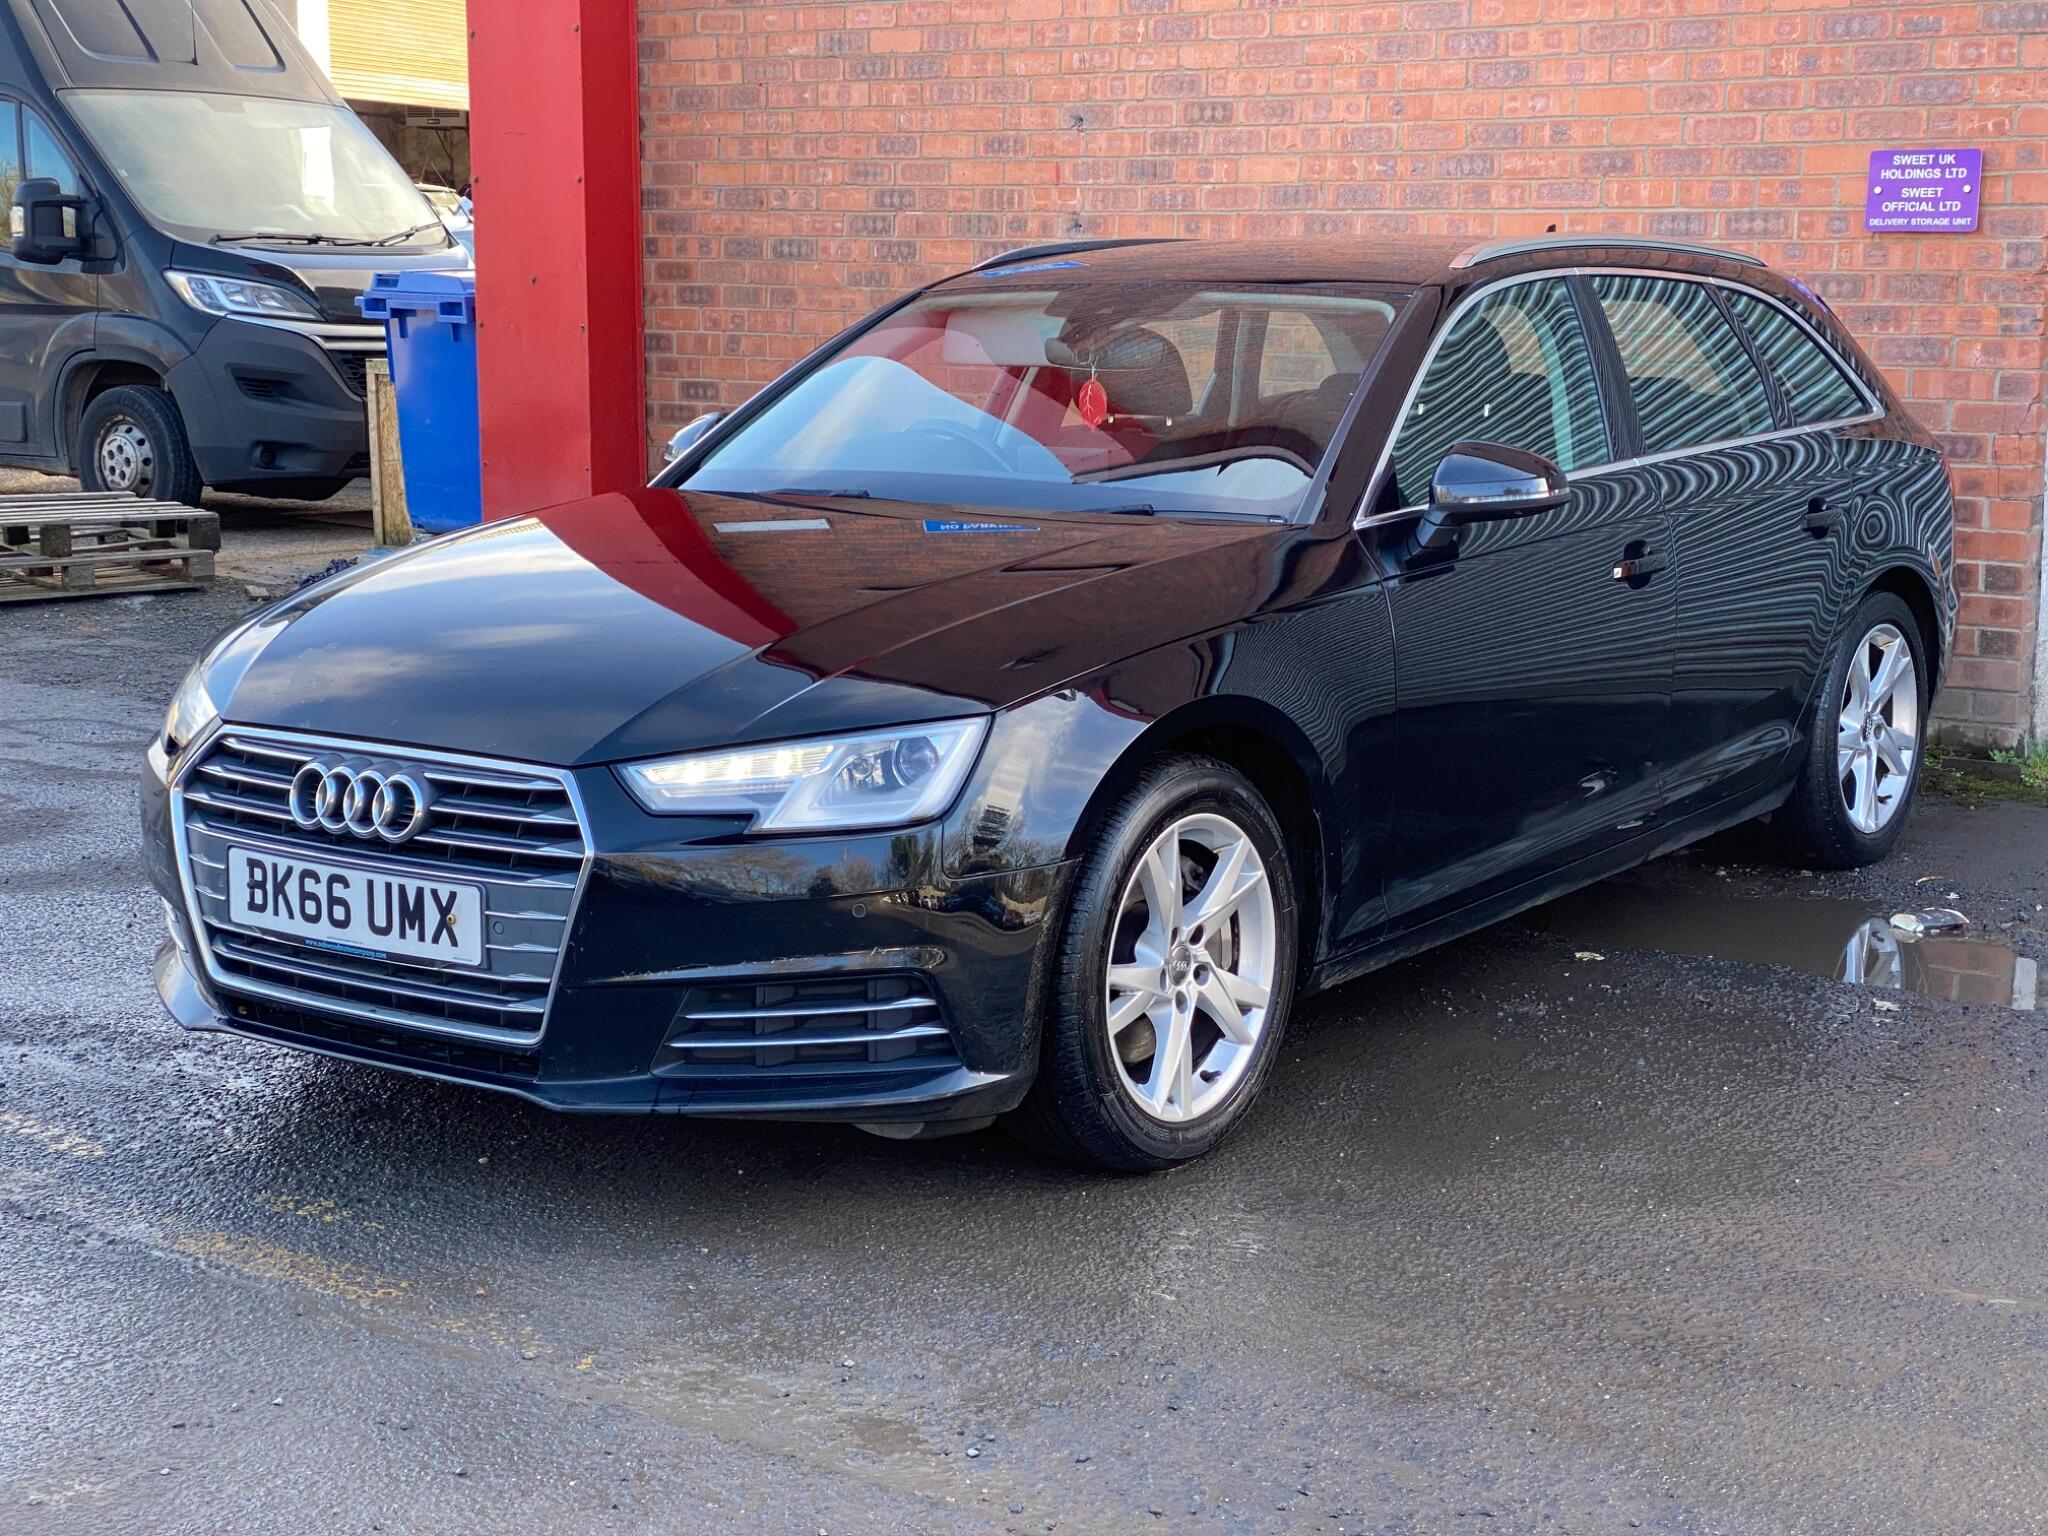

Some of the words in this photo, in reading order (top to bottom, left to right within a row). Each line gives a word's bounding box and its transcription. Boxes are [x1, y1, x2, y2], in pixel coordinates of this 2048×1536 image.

[1893, 154, 1935, 165] SWEET
[1939, 154, 1956, 164] UK
[1880, 168, 1941, 179] HOLDINGS
[1945, 167, 1967, 178] LTD
[1901, 187, 1944, 198] SWEET
[1882, 201, 1935, 212] OFFICIAL
[1939, 201, 1961, 211] LTD
[1869, 218, 1909, 226] DELIVERY
[1911, 218, 1950, 226] STORAGE
[1953, 217, 1972, 225] UNIT
[246, 857, 351, 930] BK66
[367, 878, 459, 948] UMX
